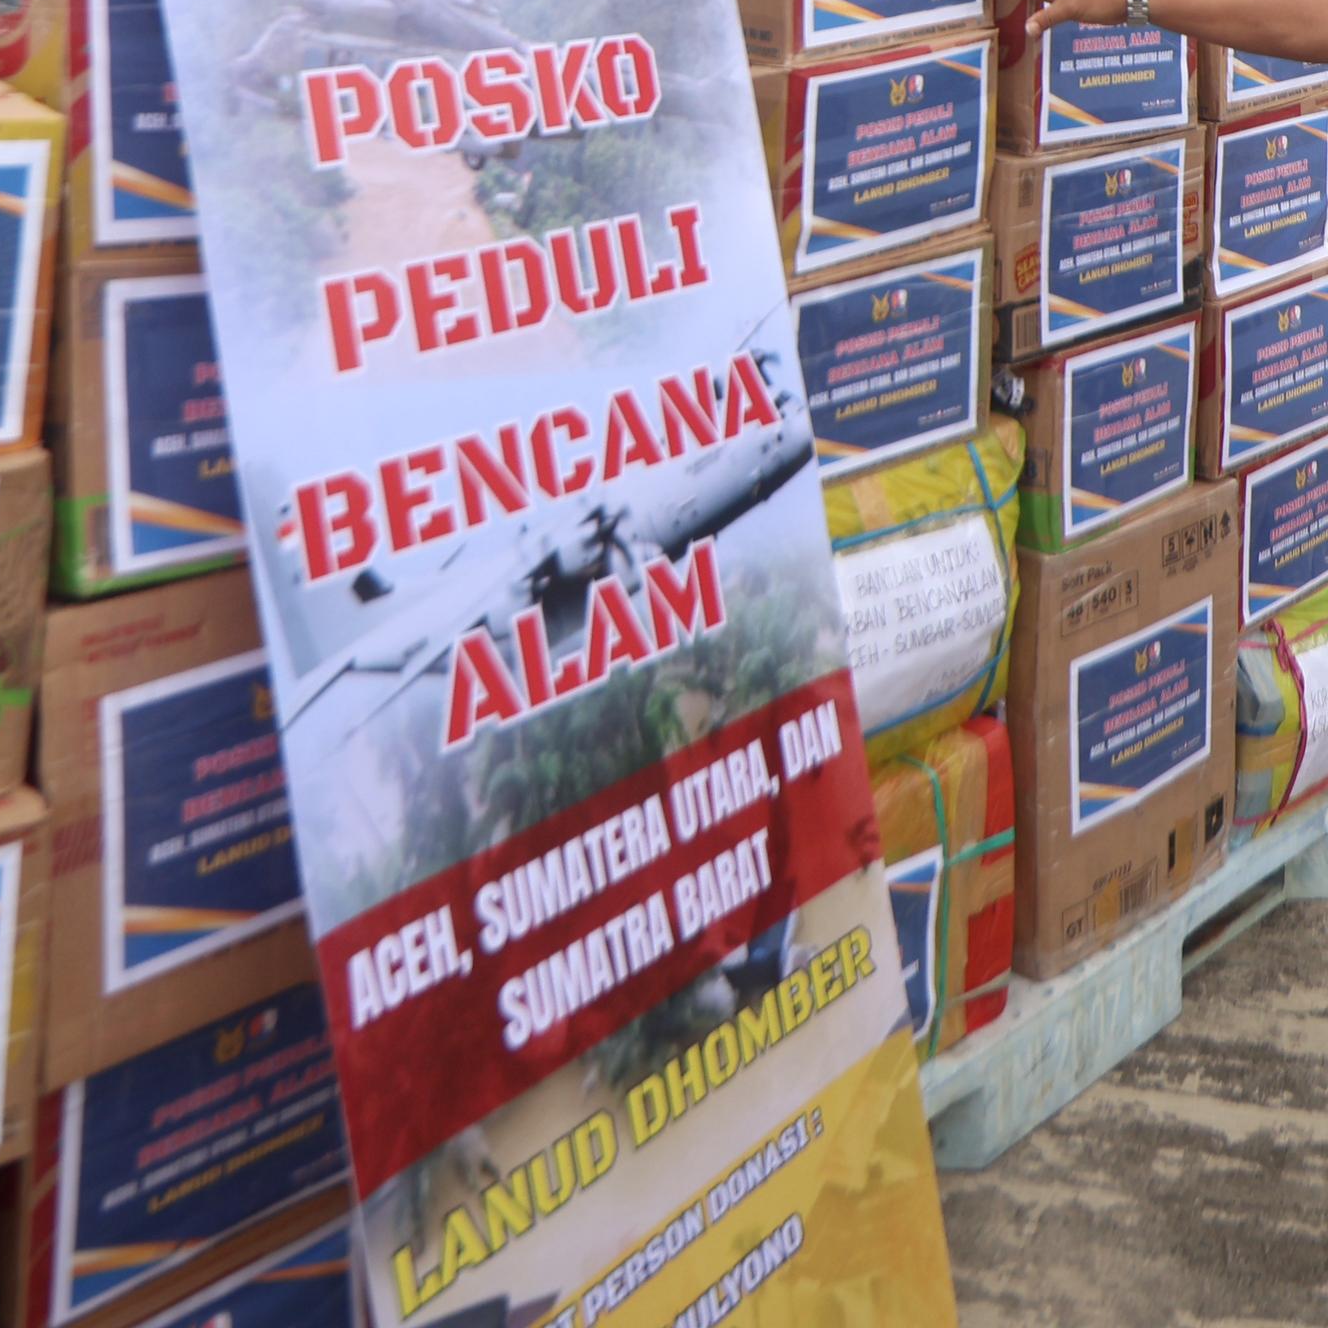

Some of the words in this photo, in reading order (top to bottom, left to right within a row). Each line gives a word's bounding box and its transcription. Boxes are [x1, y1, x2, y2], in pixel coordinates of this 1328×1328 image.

[1072, 34, 1127, 53] BENCANA
[1129, 30, 1160, 46] ALAM
[1079, 74, 1110, 87] LANUD
[1111, 69, 1154, 84] DHOMBER
[300, 32, 662, 170] POSKO
[855, 114, 903, 141] POSKO
[904, 103, 953, 129] PEDULI
[846, 135, 916, 168] BENCANA
[918, 123, 957, 147] ALAM
[854, 182, 894, 205] LANUD
[895, 166, 949, 192] DHOMBER
[1239, 183, 1284, 208] BENCANA
[1285, 175, 1311, 194] ALAM
[1245, 167, 1275, 187] POSKO
[1276, 158, 1308, 179] PEDULI
[1245, 221, 1270, 238] LANUD
[1271, 210, 1306, 230] DHOMBER
[322, 204, 712, 376] PEDULI
[1251, 353, 1298, 384] BENCANA
[1300, 341, 1327, 363] ALAM
[1256, 338, 1288, 362] POSKO
[1289, 324, 1323, 350] PEDULI
[1258, 392, 1284, 412] LANUD
[1286, 376, 1322, 401] DHOMBER
[290, 349, 782, 586] BENCANA
[442, 536, 728, 755] ALAM
[347, 905, 474, 1030] ACEH,
[474, 796, 671, 956] SUMATERA
[669, 738, 781, 843] UTARA,
[778, 700, 843, 802] DAN
[499, 890, 674, 1053] SUMATRA
[674, 828, 772, 942] BARAT
[389, 1109, 618, 1321] LANUD
[624, 925, 876, 1150] DHOMBER
[582, 1201, 705, 1328] PERSON
[706, 1117, 811, 1224] DONASI
